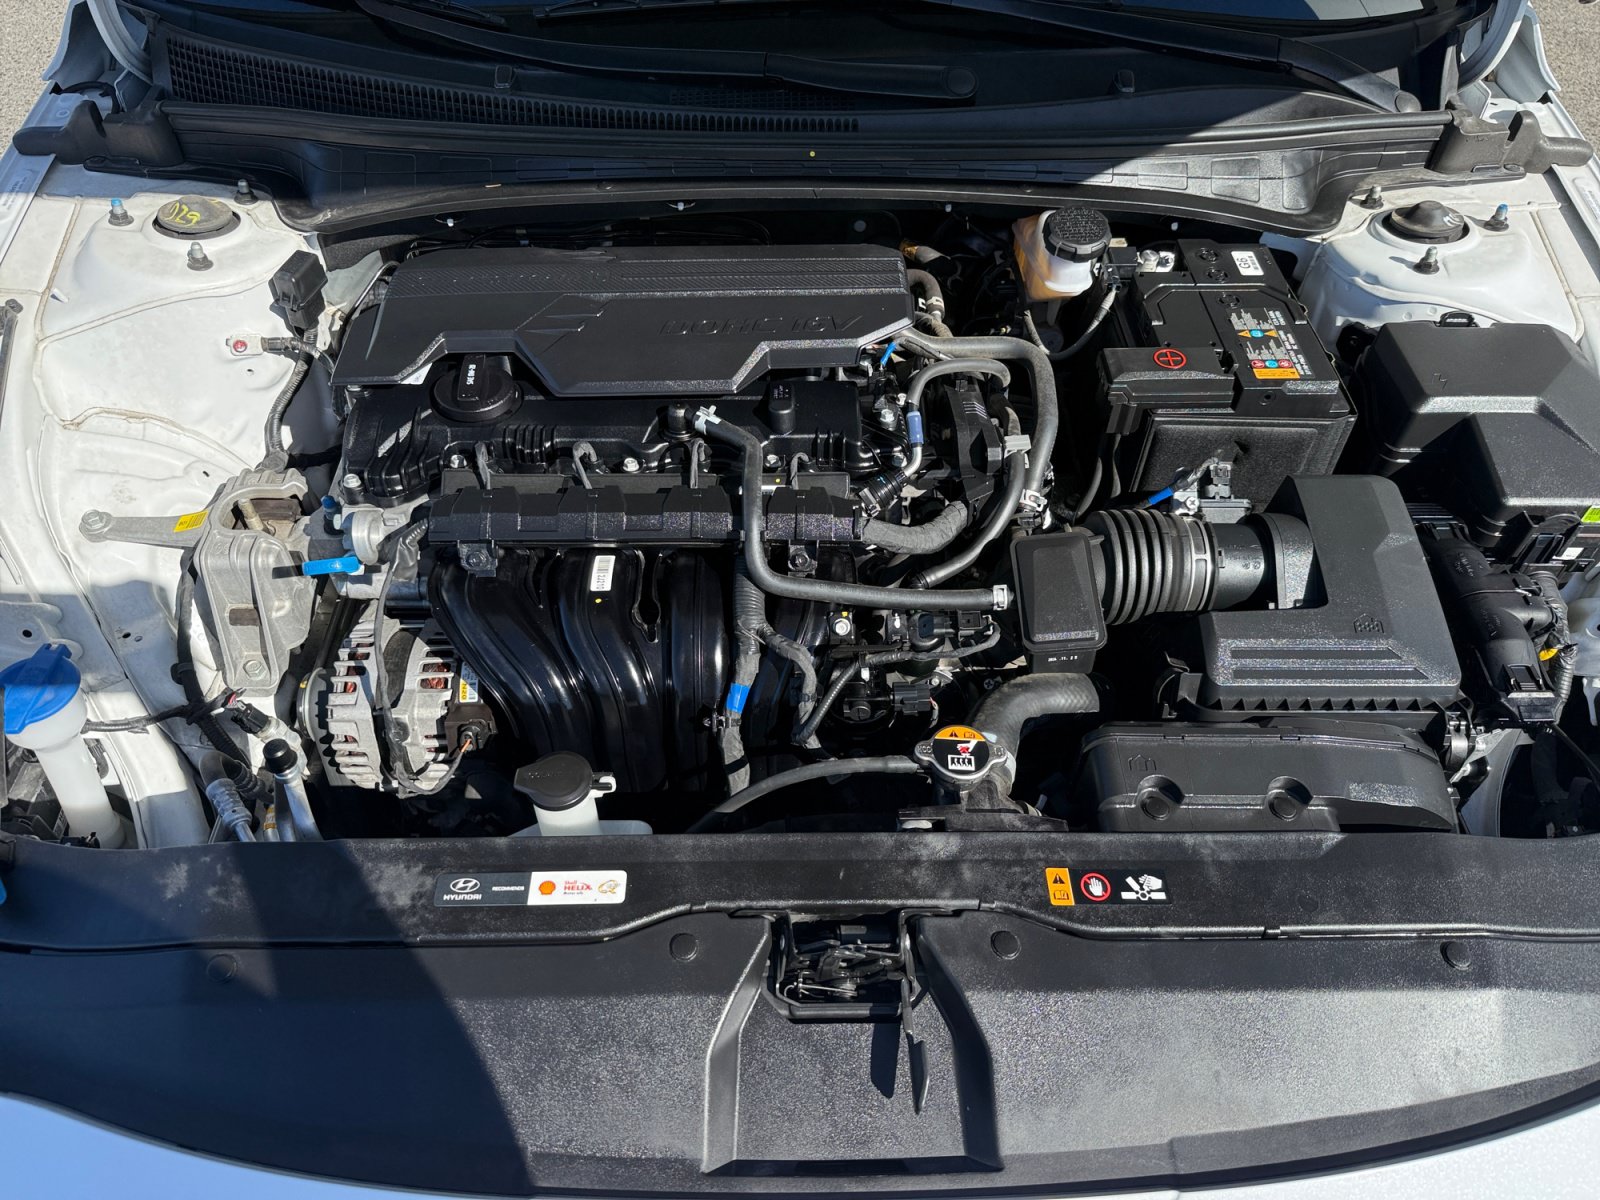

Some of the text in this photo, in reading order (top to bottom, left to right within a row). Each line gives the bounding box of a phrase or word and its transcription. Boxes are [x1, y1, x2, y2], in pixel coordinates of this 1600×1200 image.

[1237, 257, 1252, 270] G6
[659, 316, 784, 336] DOHC
[442, 893, 483, 901] HYUNDAI
